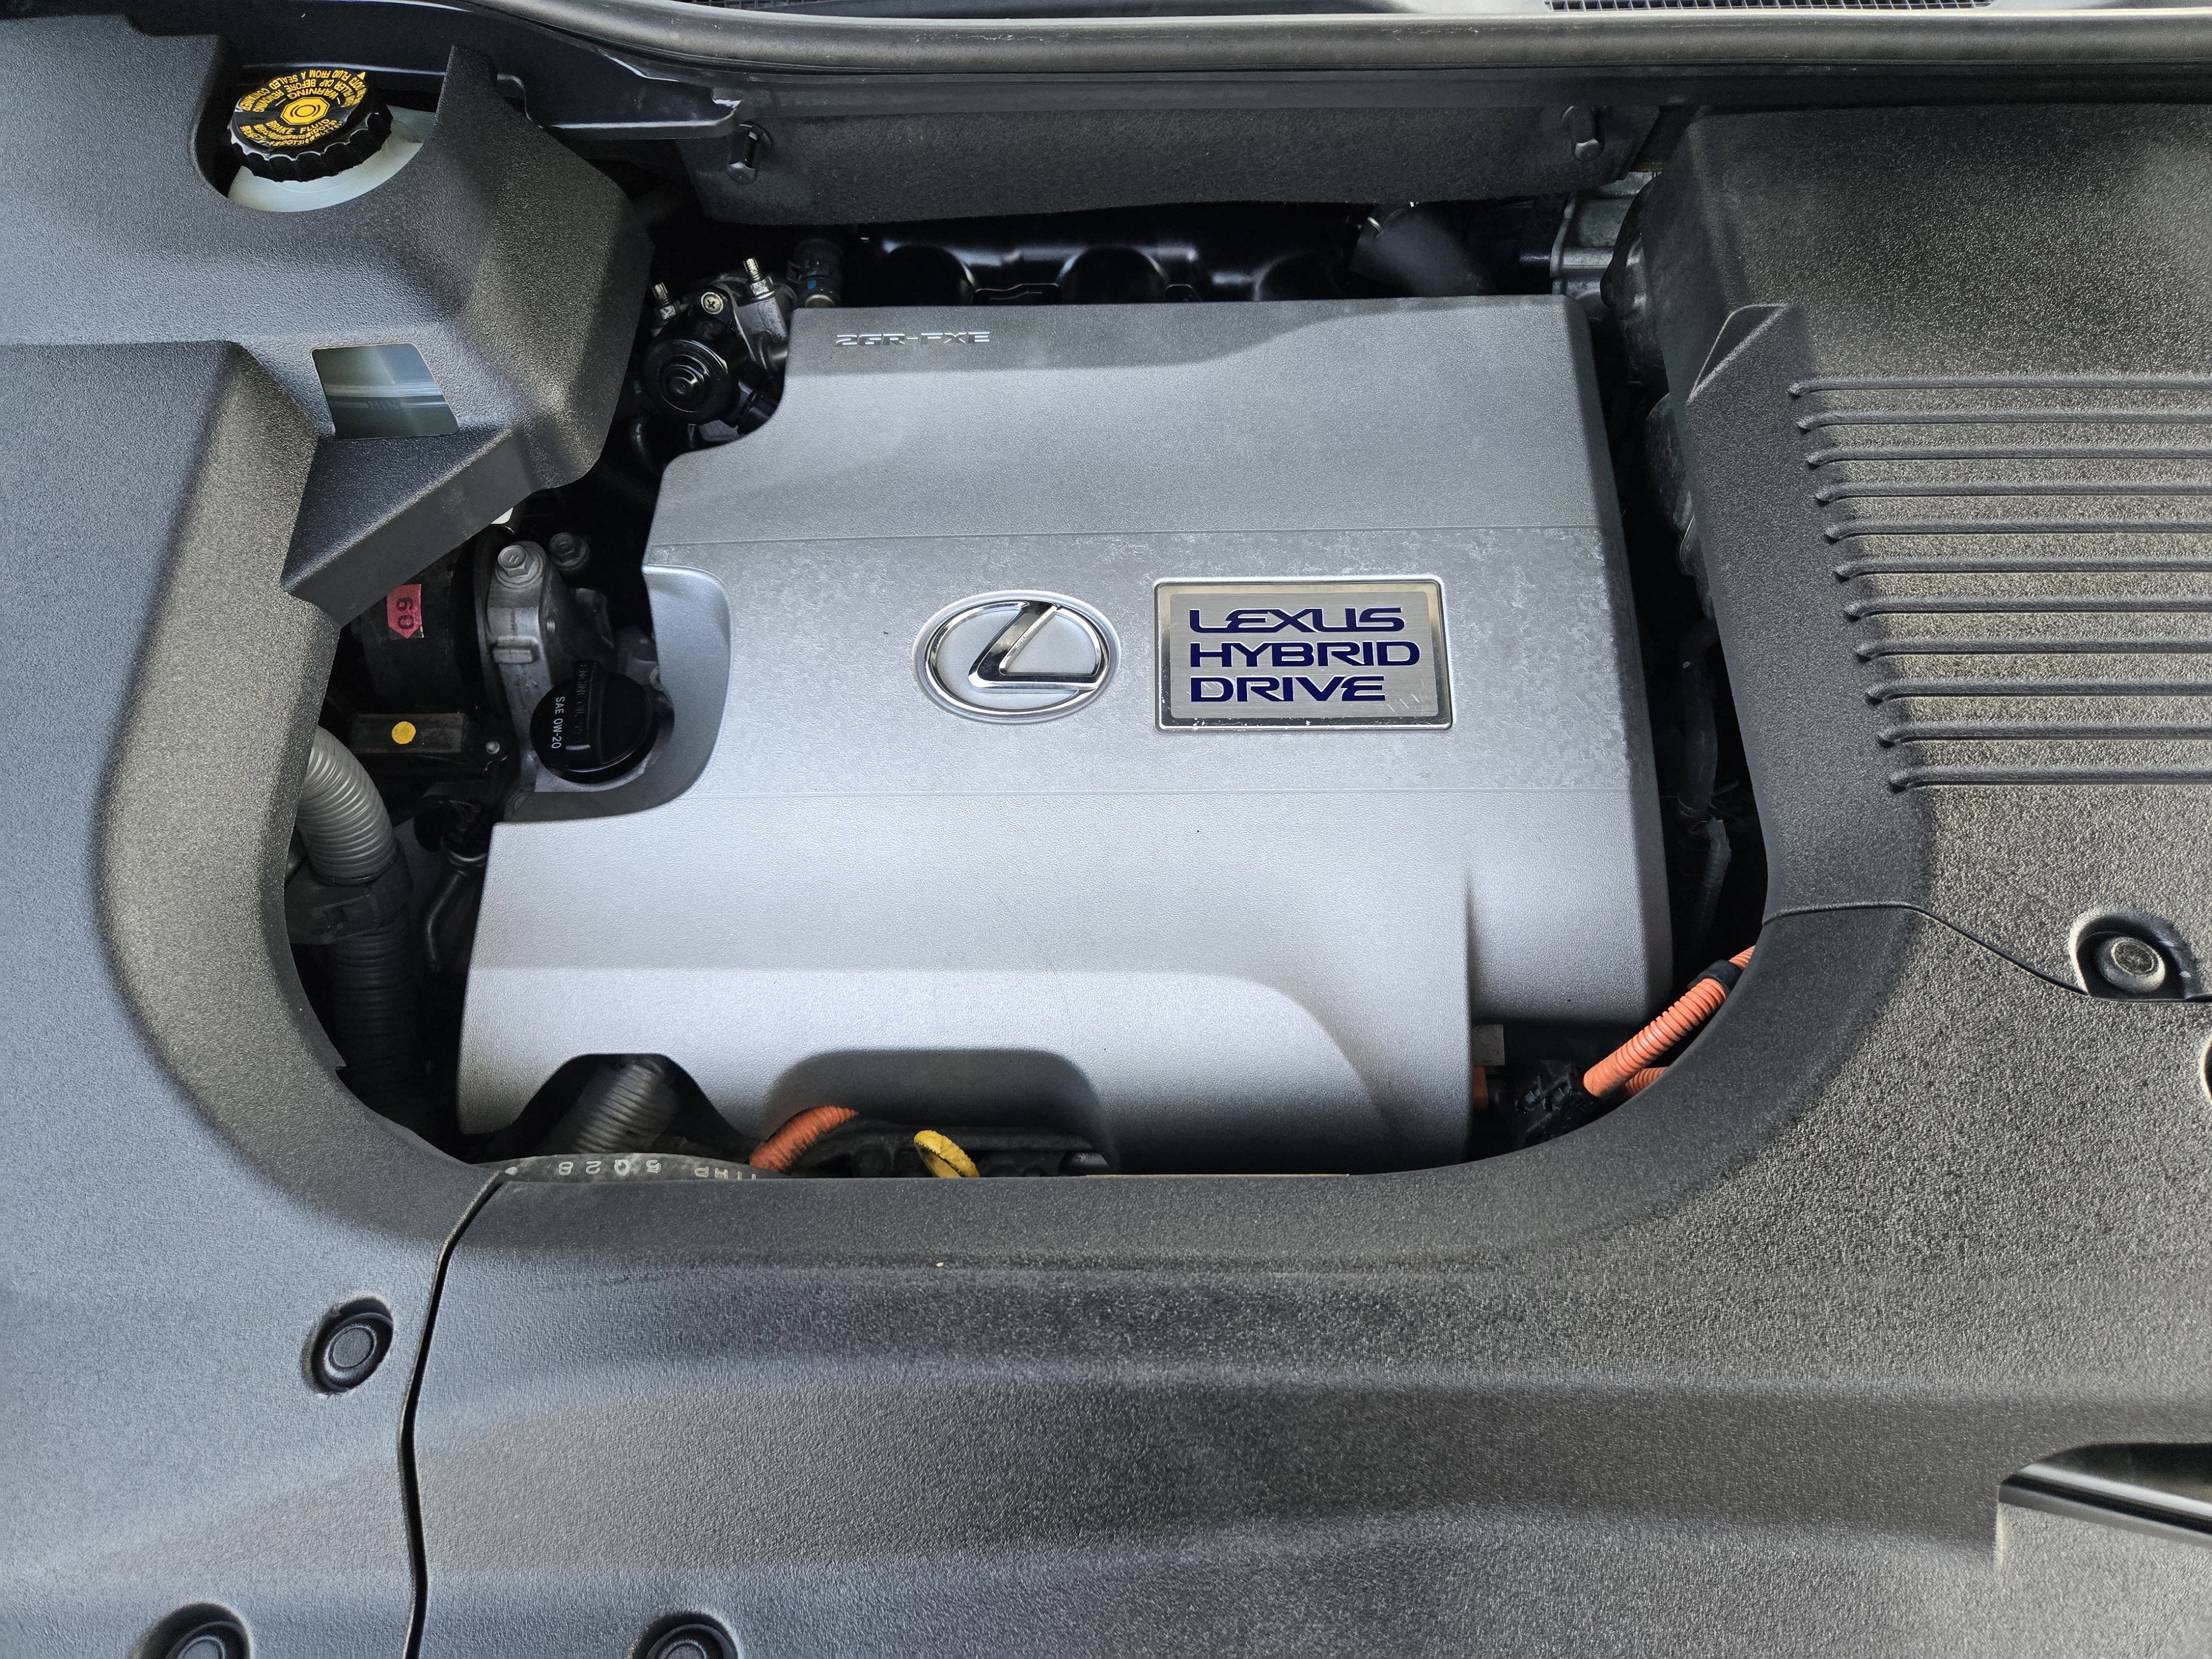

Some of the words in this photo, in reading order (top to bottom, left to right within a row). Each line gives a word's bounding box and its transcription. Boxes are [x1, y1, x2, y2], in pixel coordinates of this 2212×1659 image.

[269, 74, 298, 89] SEALED
[319, 79, 334, 87] CAP
[332, 70, 351, 81] FLUID
[286, 79, 316, 93] BEFORE
[288, 87, 338, 100] WARNING
[334, 82, 355, 97] FILLER
[239, 88, 270, 111] CONTAINER
[253, 90, 285, 112] REMOVING
[265, 121, 295, 134] BRAKE
[300, 119, 330, 134] FLUID
[835, 331, 990, 346] 2GR-FXE
[1189, 607, 1406, 633] LEXUS
[1190, 640, 1421, 667] HYBRID
[1190, 675, 1386, 702] DRIVE
[555, 696, 566, 714] SAE
[551, 718, 564, 749] 0W-20
